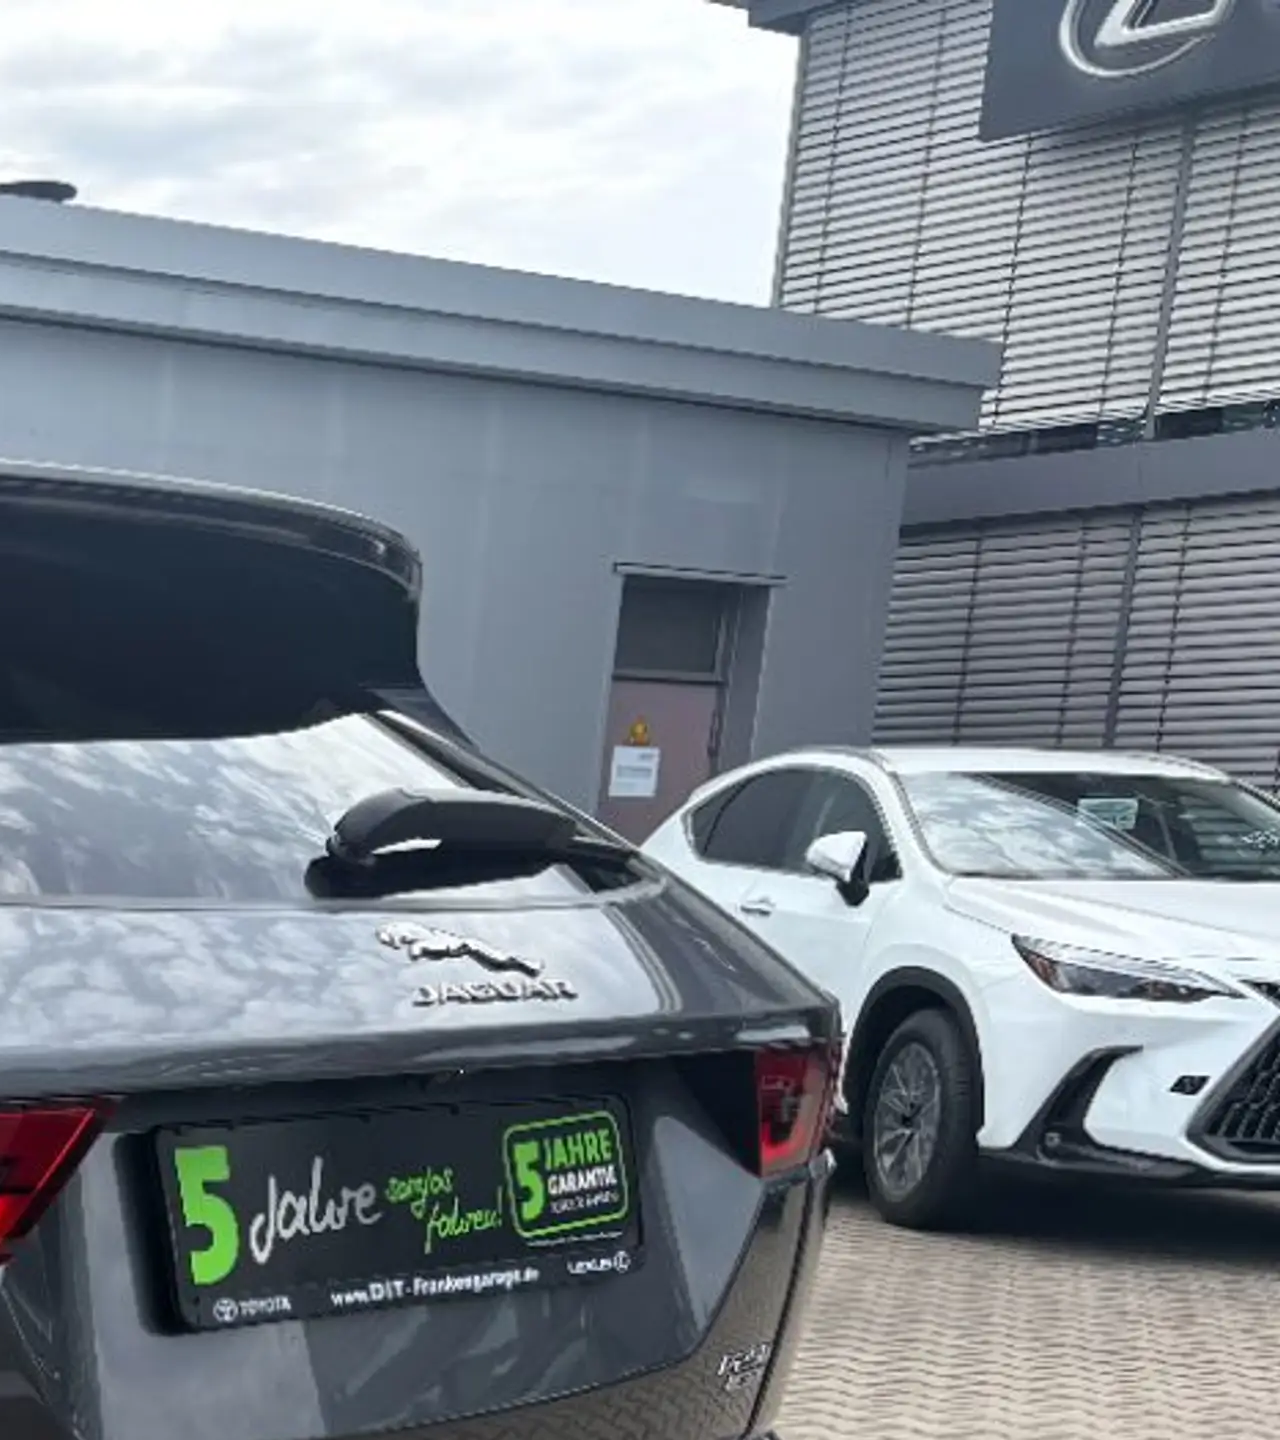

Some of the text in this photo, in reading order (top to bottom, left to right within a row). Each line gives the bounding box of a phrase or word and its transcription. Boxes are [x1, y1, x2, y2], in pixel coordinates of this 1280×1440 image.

[411, 979, 579, 1007] JAGUAR
[513, 1128, 613, 1222] 5 JAHRE
[547, 1163, 618, 1196] GARANTIE
[174, 1145, 383, 1285] 5 Jahre
